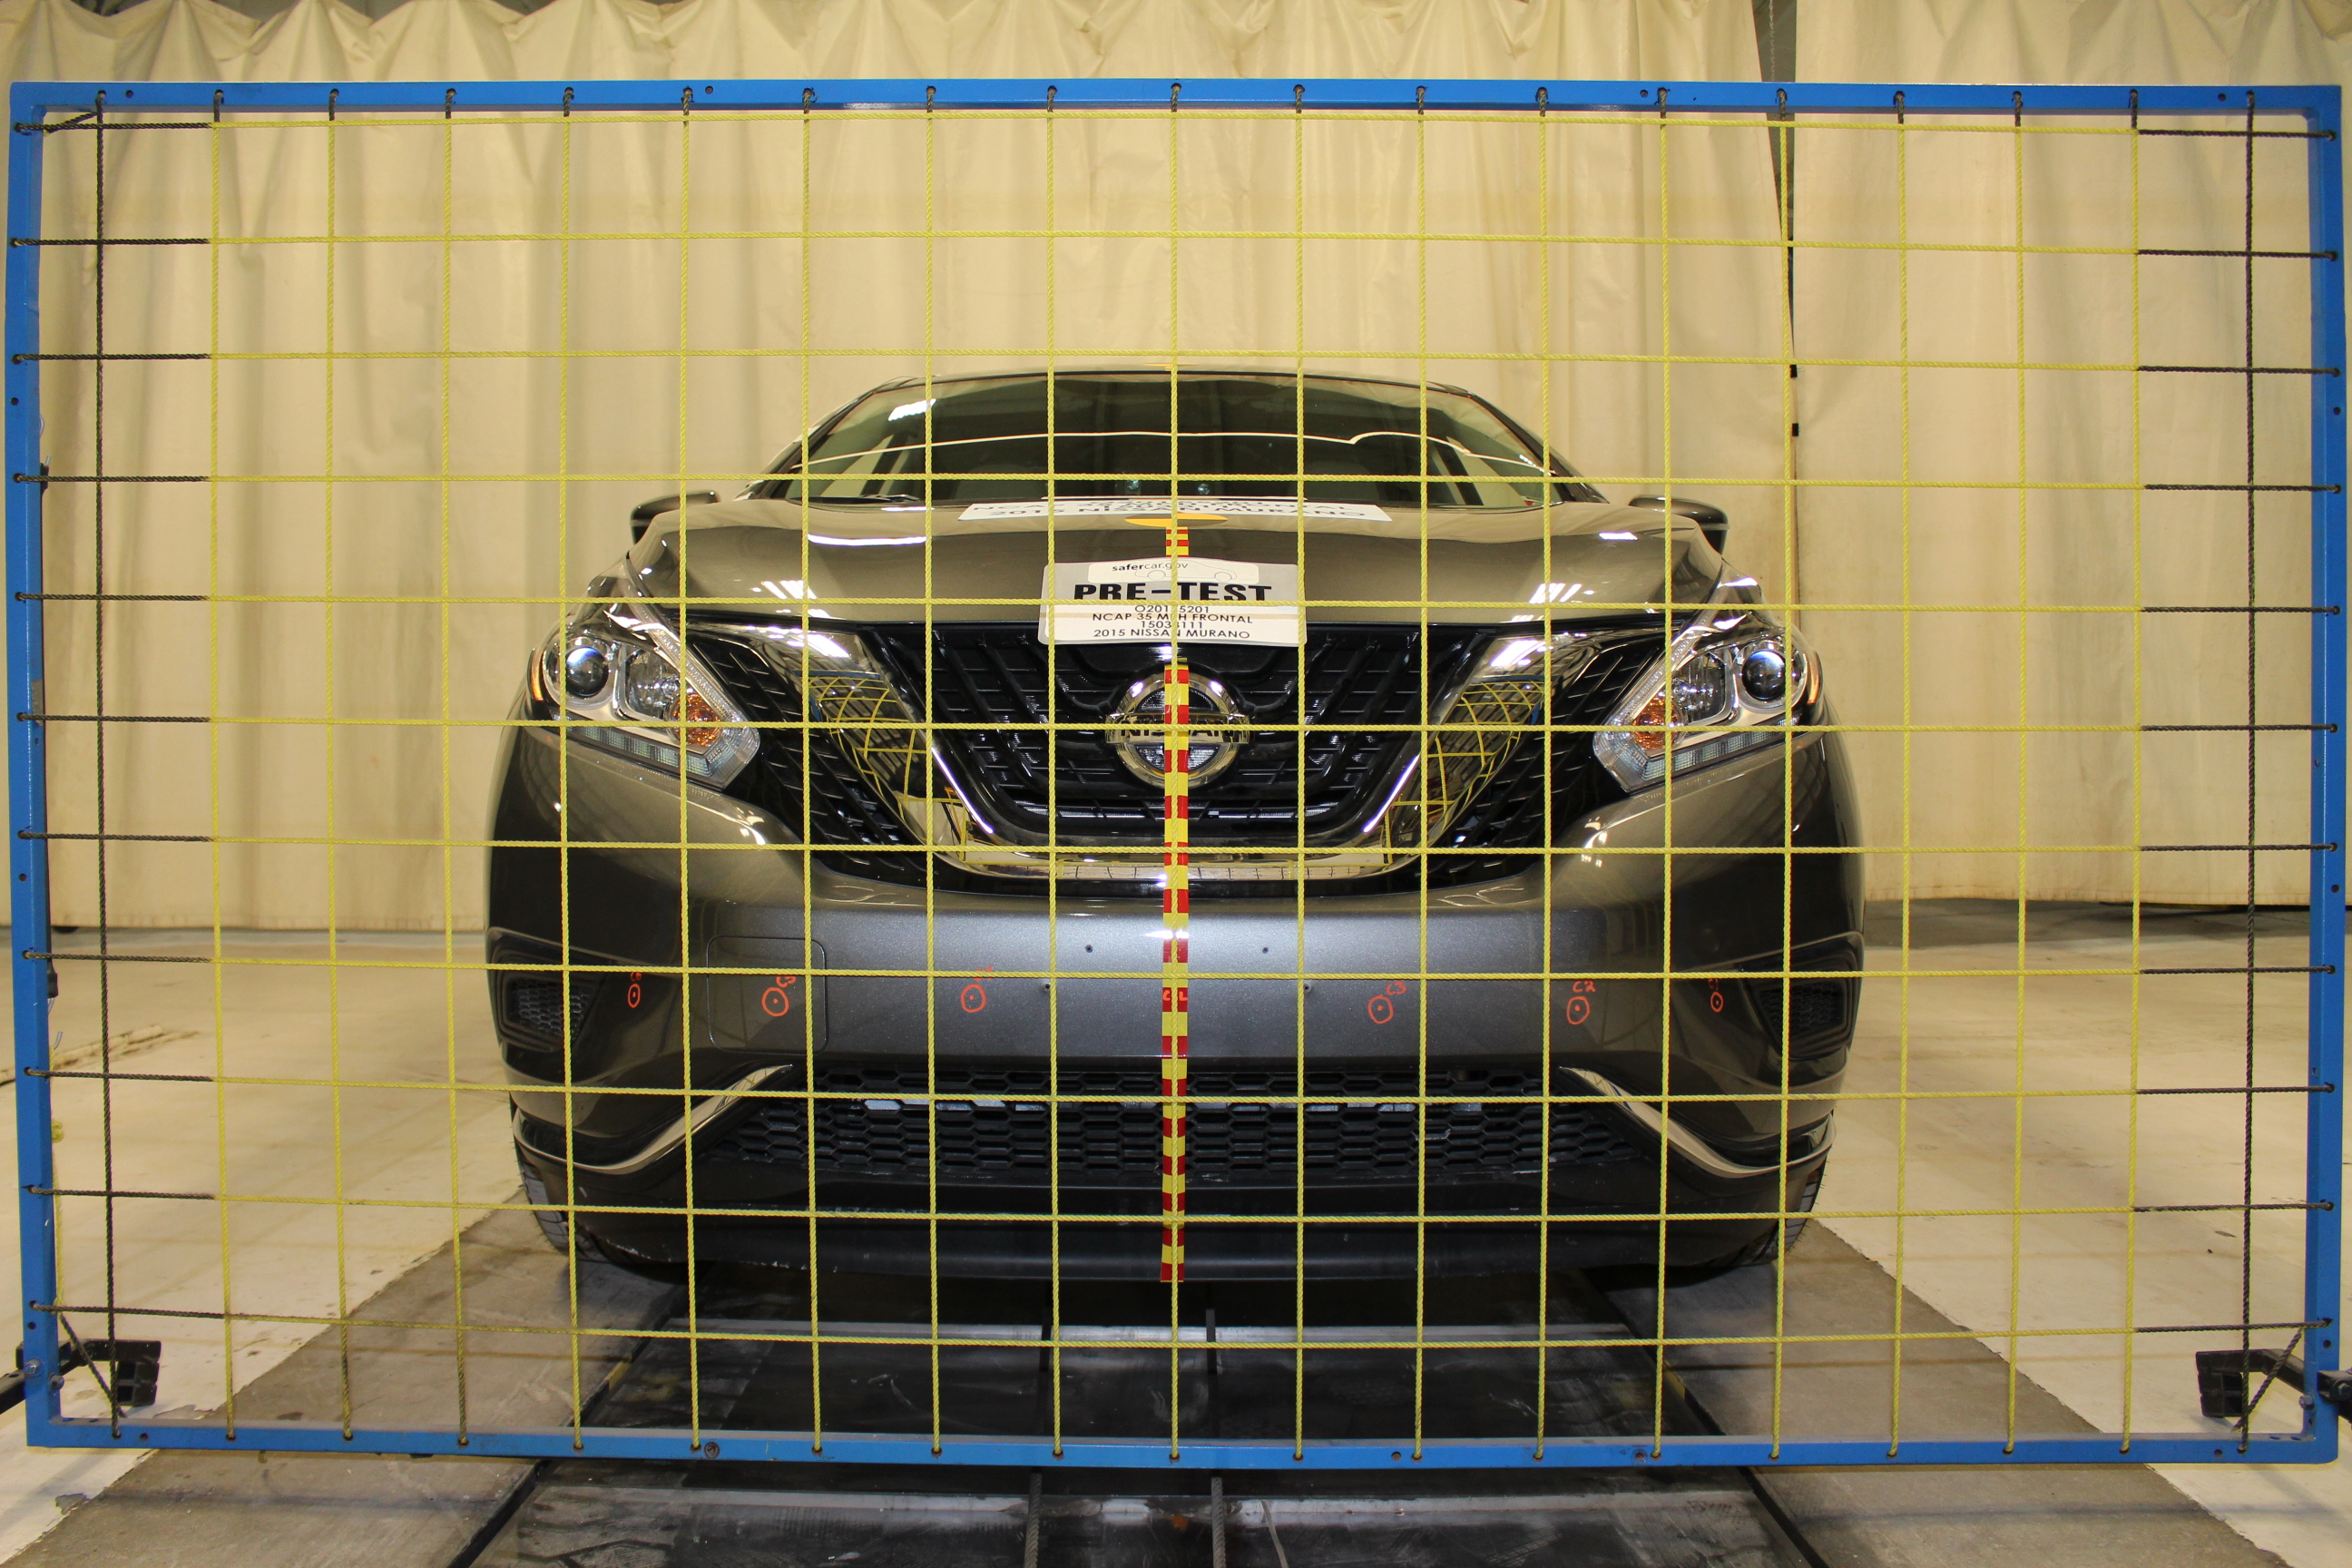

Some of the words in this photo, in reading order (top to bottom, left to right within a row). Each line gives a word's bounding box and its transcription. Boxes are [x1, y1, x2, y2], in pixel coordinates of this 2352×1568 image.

[1215, 507, 1366, 516] MURANO
[1112, 562, 1188, 572] safercar.gov
[1073, 582, 1272, 601] PRE-TEST
[1134, 604, 1209, 613] O2015201
[1092, 612, 1132, 622] NCAP
[1136, 612, 1152, 621] 35
[1192, 613, 1253, 623] FRONTAL
[1093, 629, 1125, 637] 2015
[1186, 630, 1250, 639] MURANO
[1386, 980, 1407, 995] C3
[1572, 979, 1597, 994] C2
